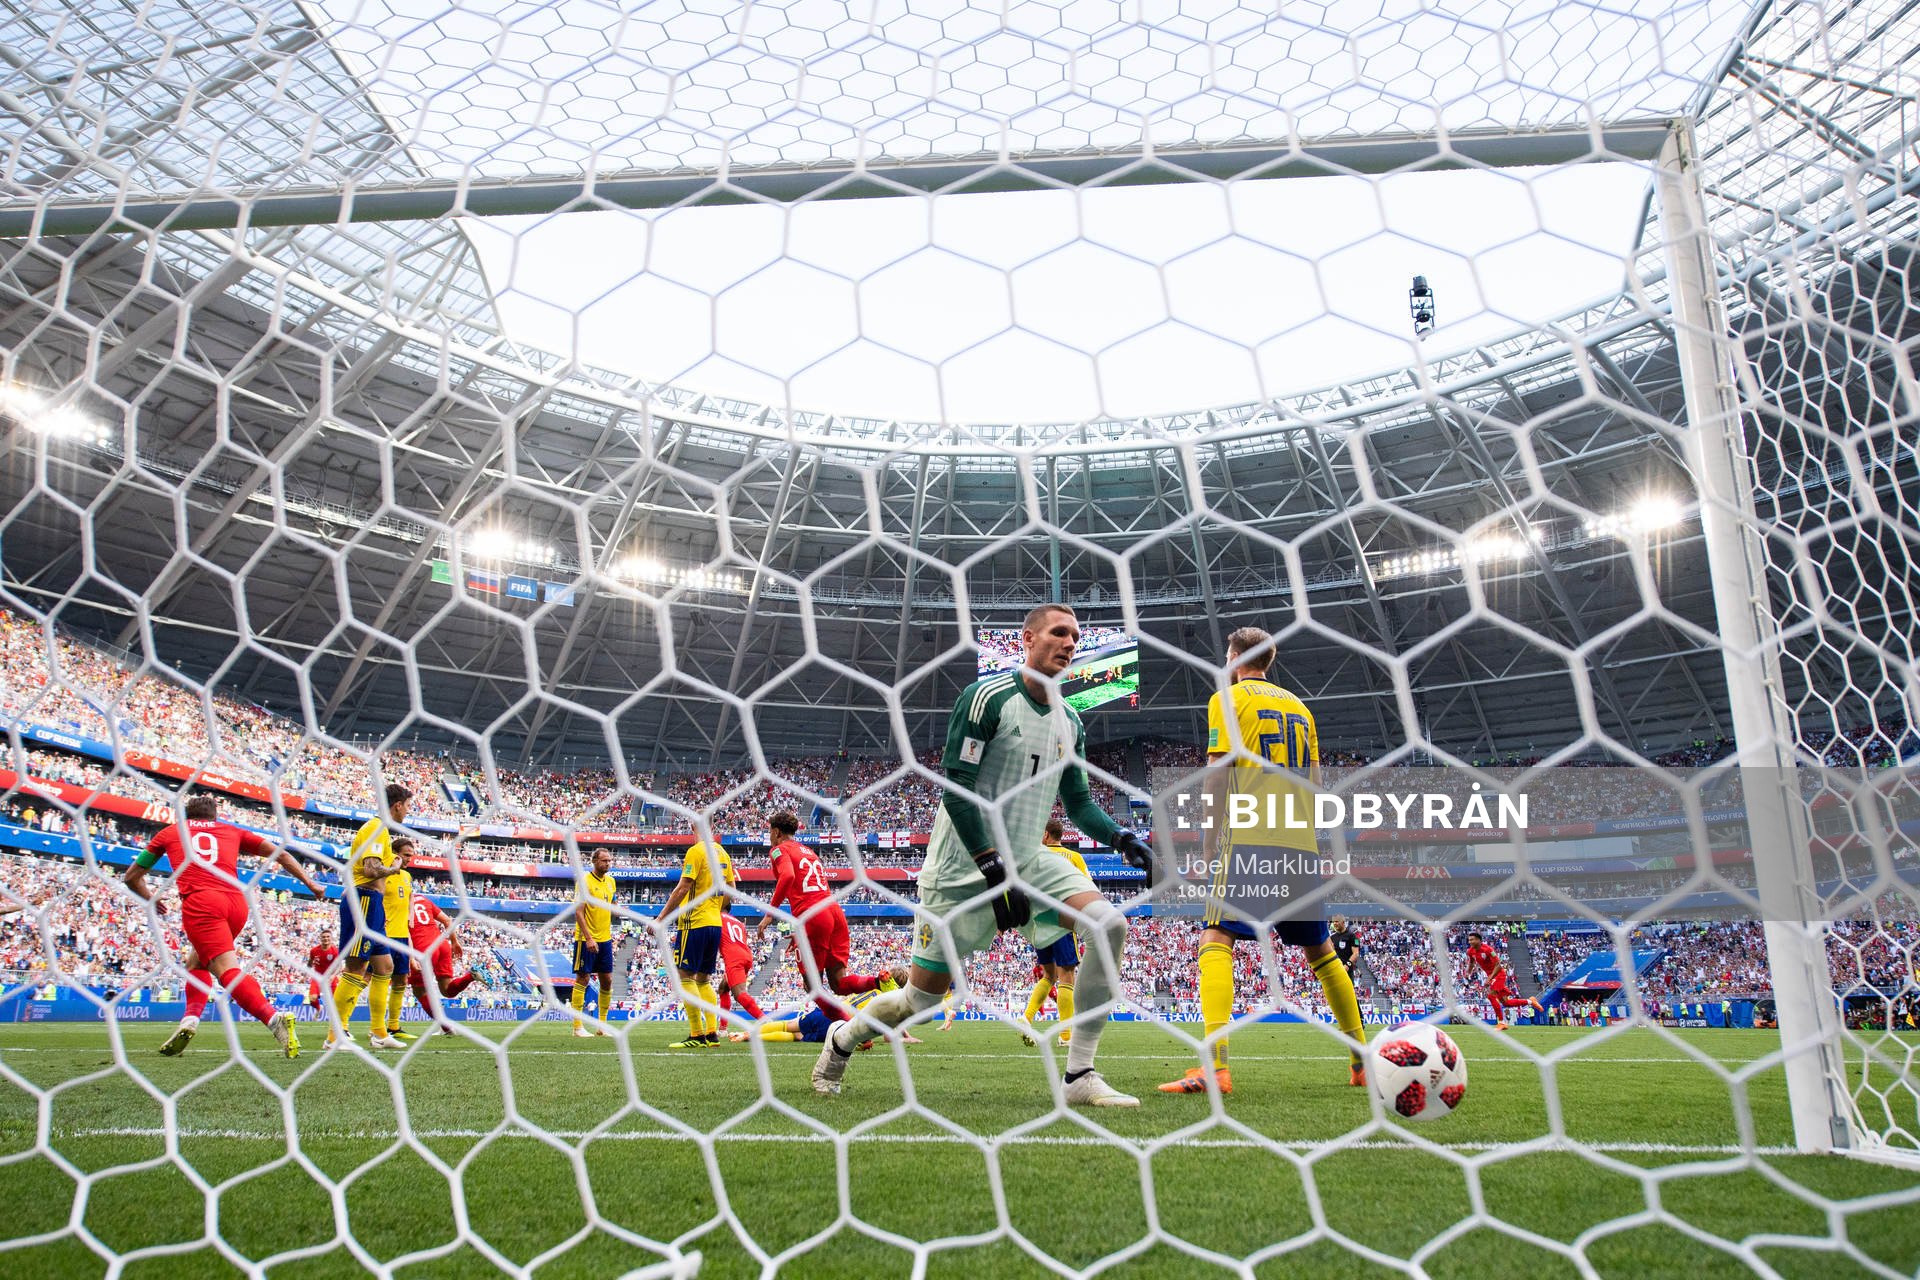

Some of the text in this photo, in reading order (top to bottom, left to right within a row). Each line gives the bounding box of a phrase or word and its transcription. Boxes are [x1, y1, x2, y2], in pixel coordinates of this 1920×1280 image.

[511, 583, 533, 595] FIFA
[1257, 709, 1311, 779] 20
[1031, 754, 1041, 787] 1
[192, 832, 218, 866] 9
[799, 858, 828, 893] 20
[1557, 865, 1584, 873] RUSSIA
[727, 921, 744, 944] 10
[98, 1006, 150, 1019] СМАРА
